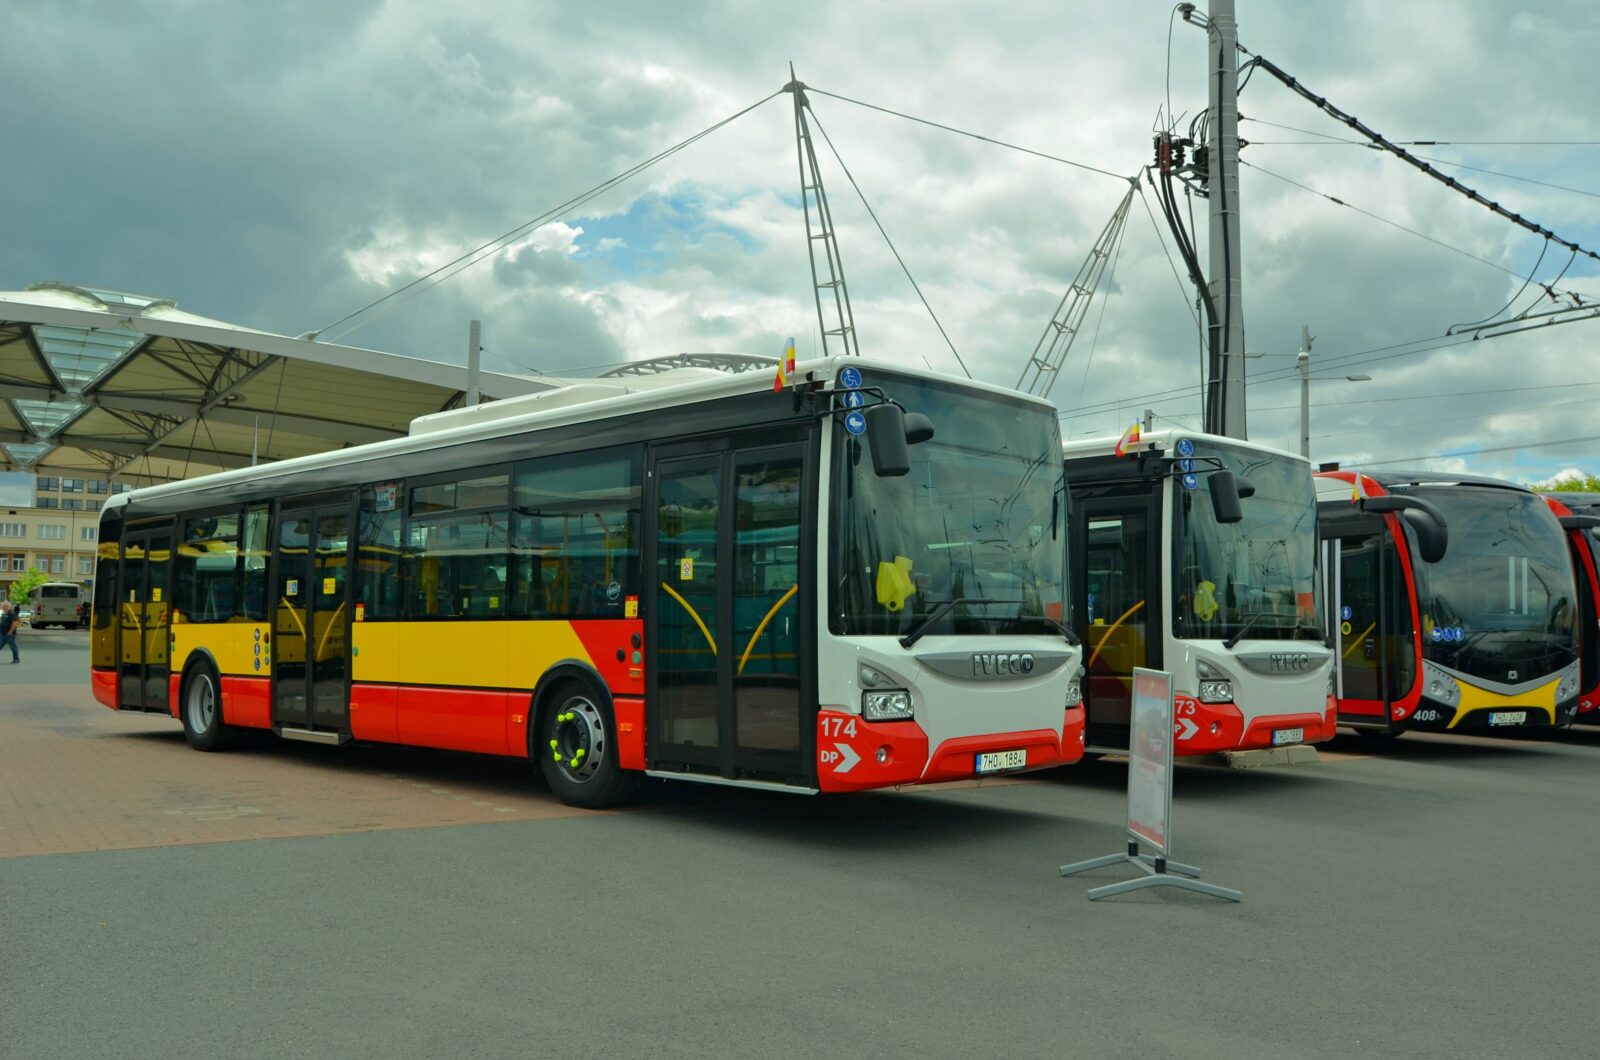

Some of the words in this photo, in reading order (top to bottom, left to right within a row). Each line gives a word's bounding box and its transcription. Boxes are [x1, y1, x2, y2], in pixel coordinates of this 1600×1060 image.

[974, 654, 1034, 676] IVECO
[1271, 654, 1308, 671] IVECO
[1174, 699, 1196, 715] 73
[1413, 709, 1437, 721] 408
[821, 717, 858, 738] 174
[820, 750, 839, 763] DP
[1004, 752, 1022, 767] 1884
